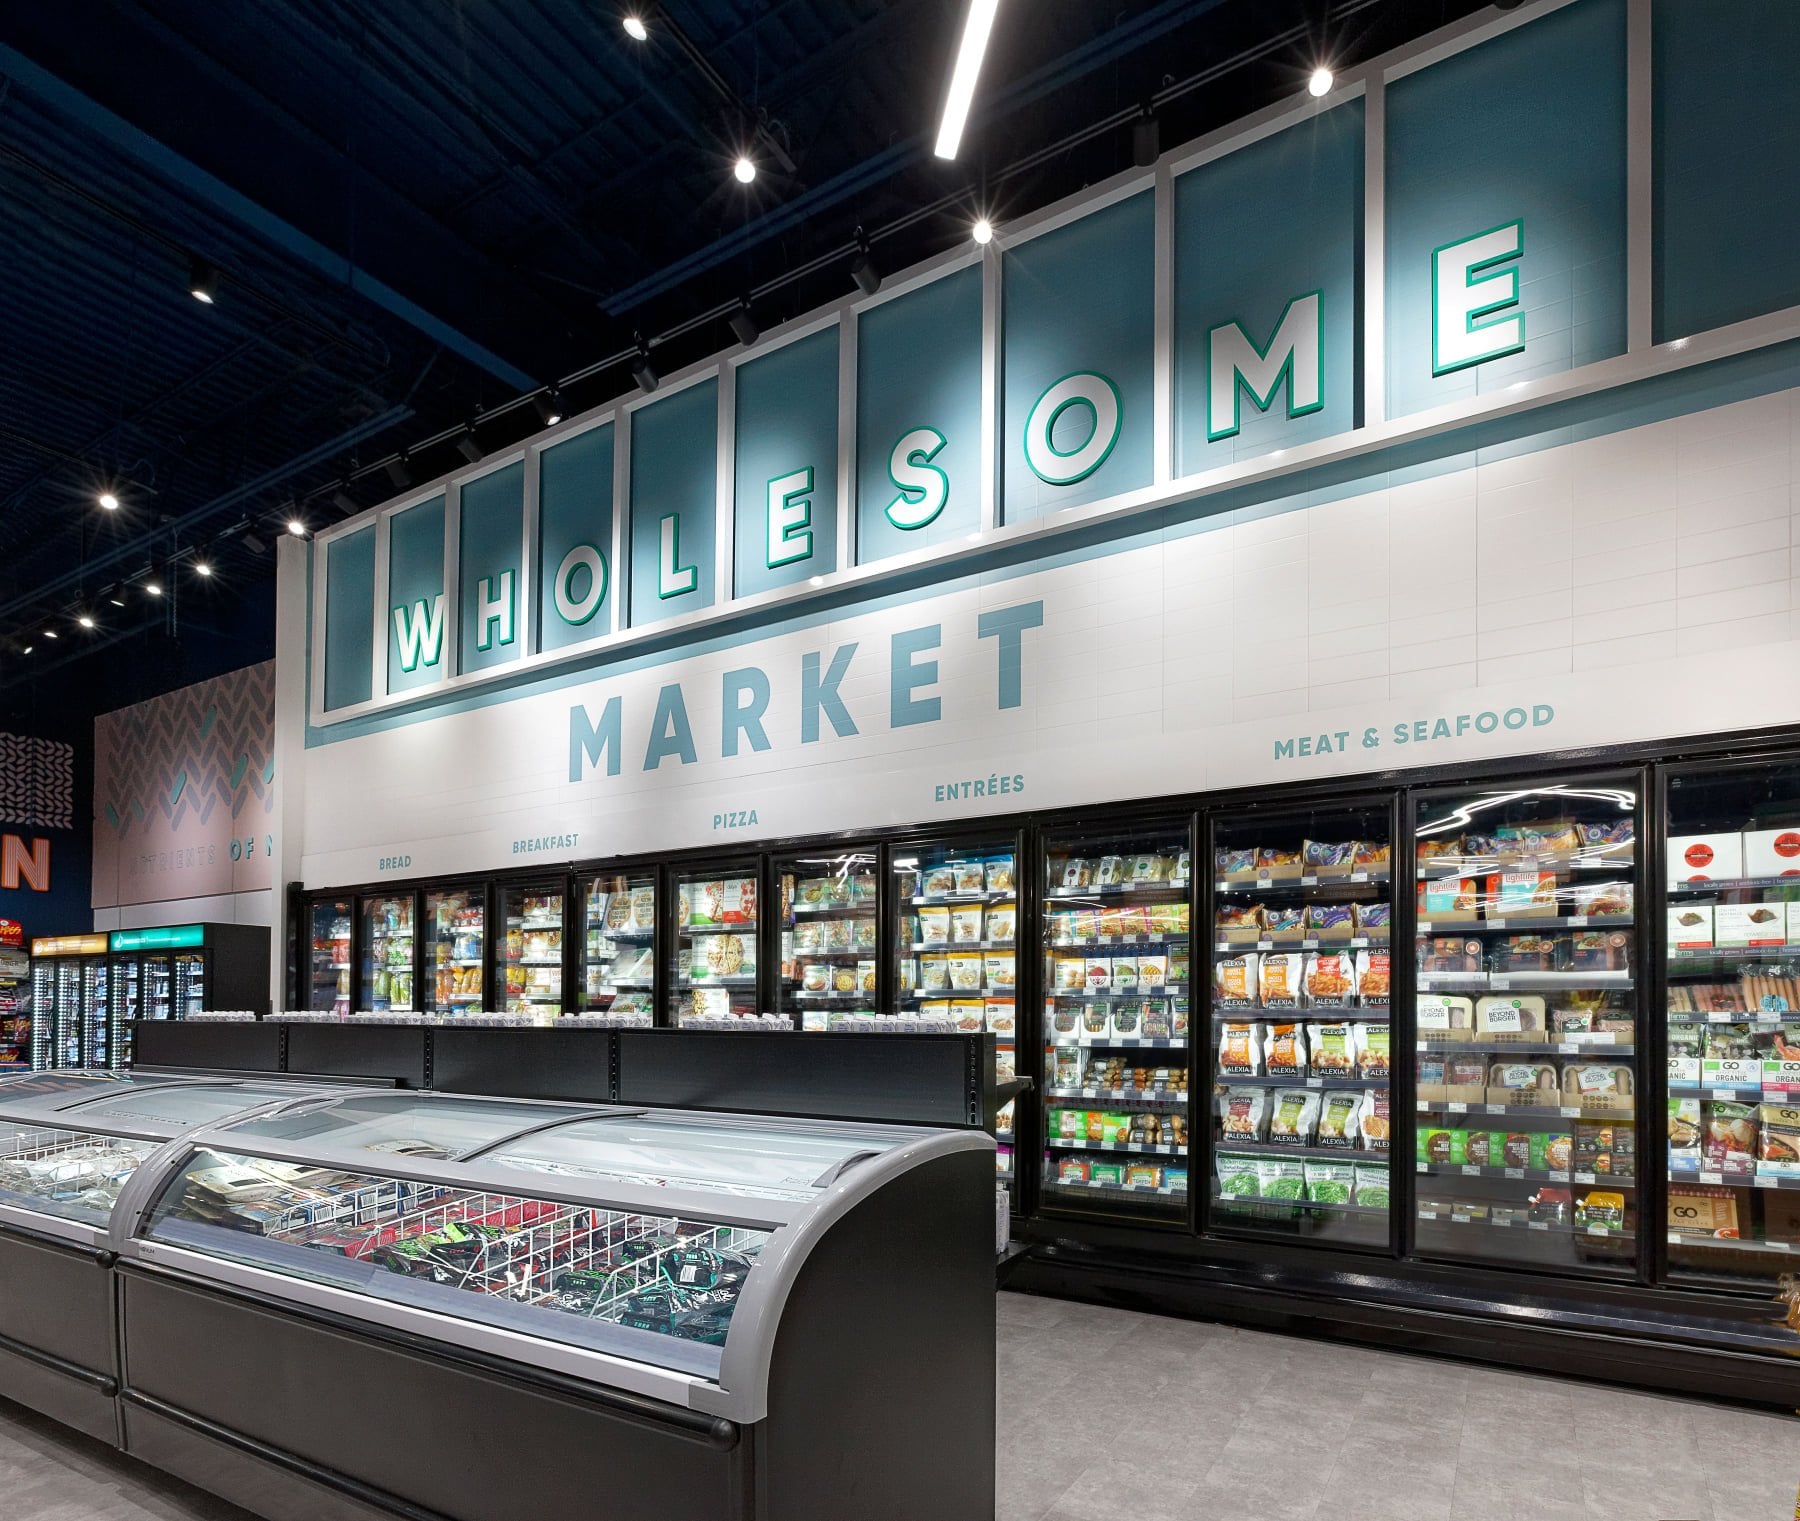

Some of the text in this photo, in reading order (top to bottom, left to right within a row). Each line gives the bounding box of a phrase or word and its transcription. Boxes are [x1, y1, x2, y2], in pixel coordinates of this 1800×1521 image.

[393, 218, 1526, 673] WHOLESOME
[569, 600, 1044, 783] MARKET
[1274, 702, 1556, 760] MEAT & SEAFOOD
[935, 772, 1025, 802] ENTRÉES
[713, 809, 759, 830] PIZZA
[230, 837, 254, 861] OF
[512, 834, 579, 854] BREAKFAST
[379, 855, 412, 870] BREAD
[1783, 1063, 1800, 1071] GO
[1716, 1074, 1747, 1082] ORGANIC
[1776, 1075, 1800, 1083] ORGAN
[1780, 1109, 1798, 1120] GO
[1228, 1132, 1251, 1140] ALEXIA
[1373, 1140, 1389, 1148] ALEX
[1674, 1207, 1698, 1218] GO
